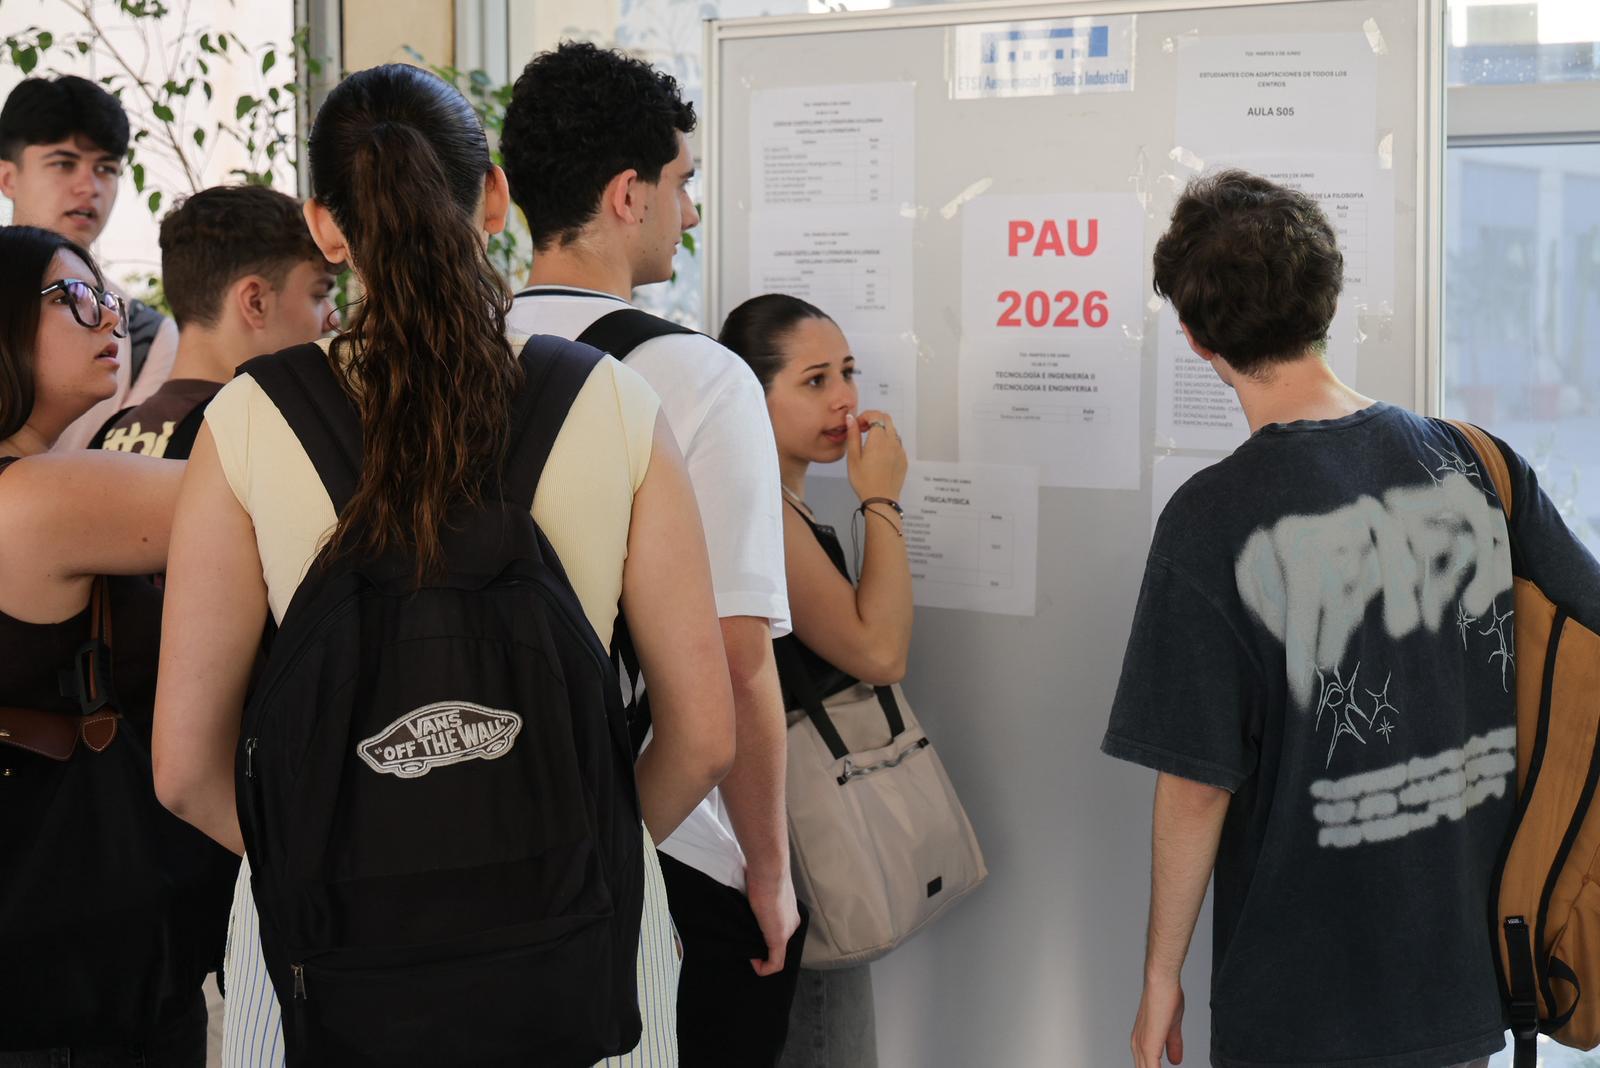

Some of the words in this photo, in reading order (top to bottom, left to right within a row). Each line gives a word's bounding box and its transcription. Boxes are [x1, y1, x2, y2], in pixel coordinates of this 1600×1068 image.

[1085, 69, 1128, 86] Industrial
[1199, 71, 1239, 79] ESTUDIANTES
[1247, 107, 1274, 117] AULA
[1276, 107, 1295, 117] S05
[1008, 219, 1099, 257] PAU
[996, 289, 1110, 328] 2026
[1042, 372, 1047, 380] E
[1042, 384, 1047, 392] E
[1048, 384, 1092, 393] ENGINYERIA
[404, 709, 463, 739] VANS
[417, 729, 461, 756] THE
